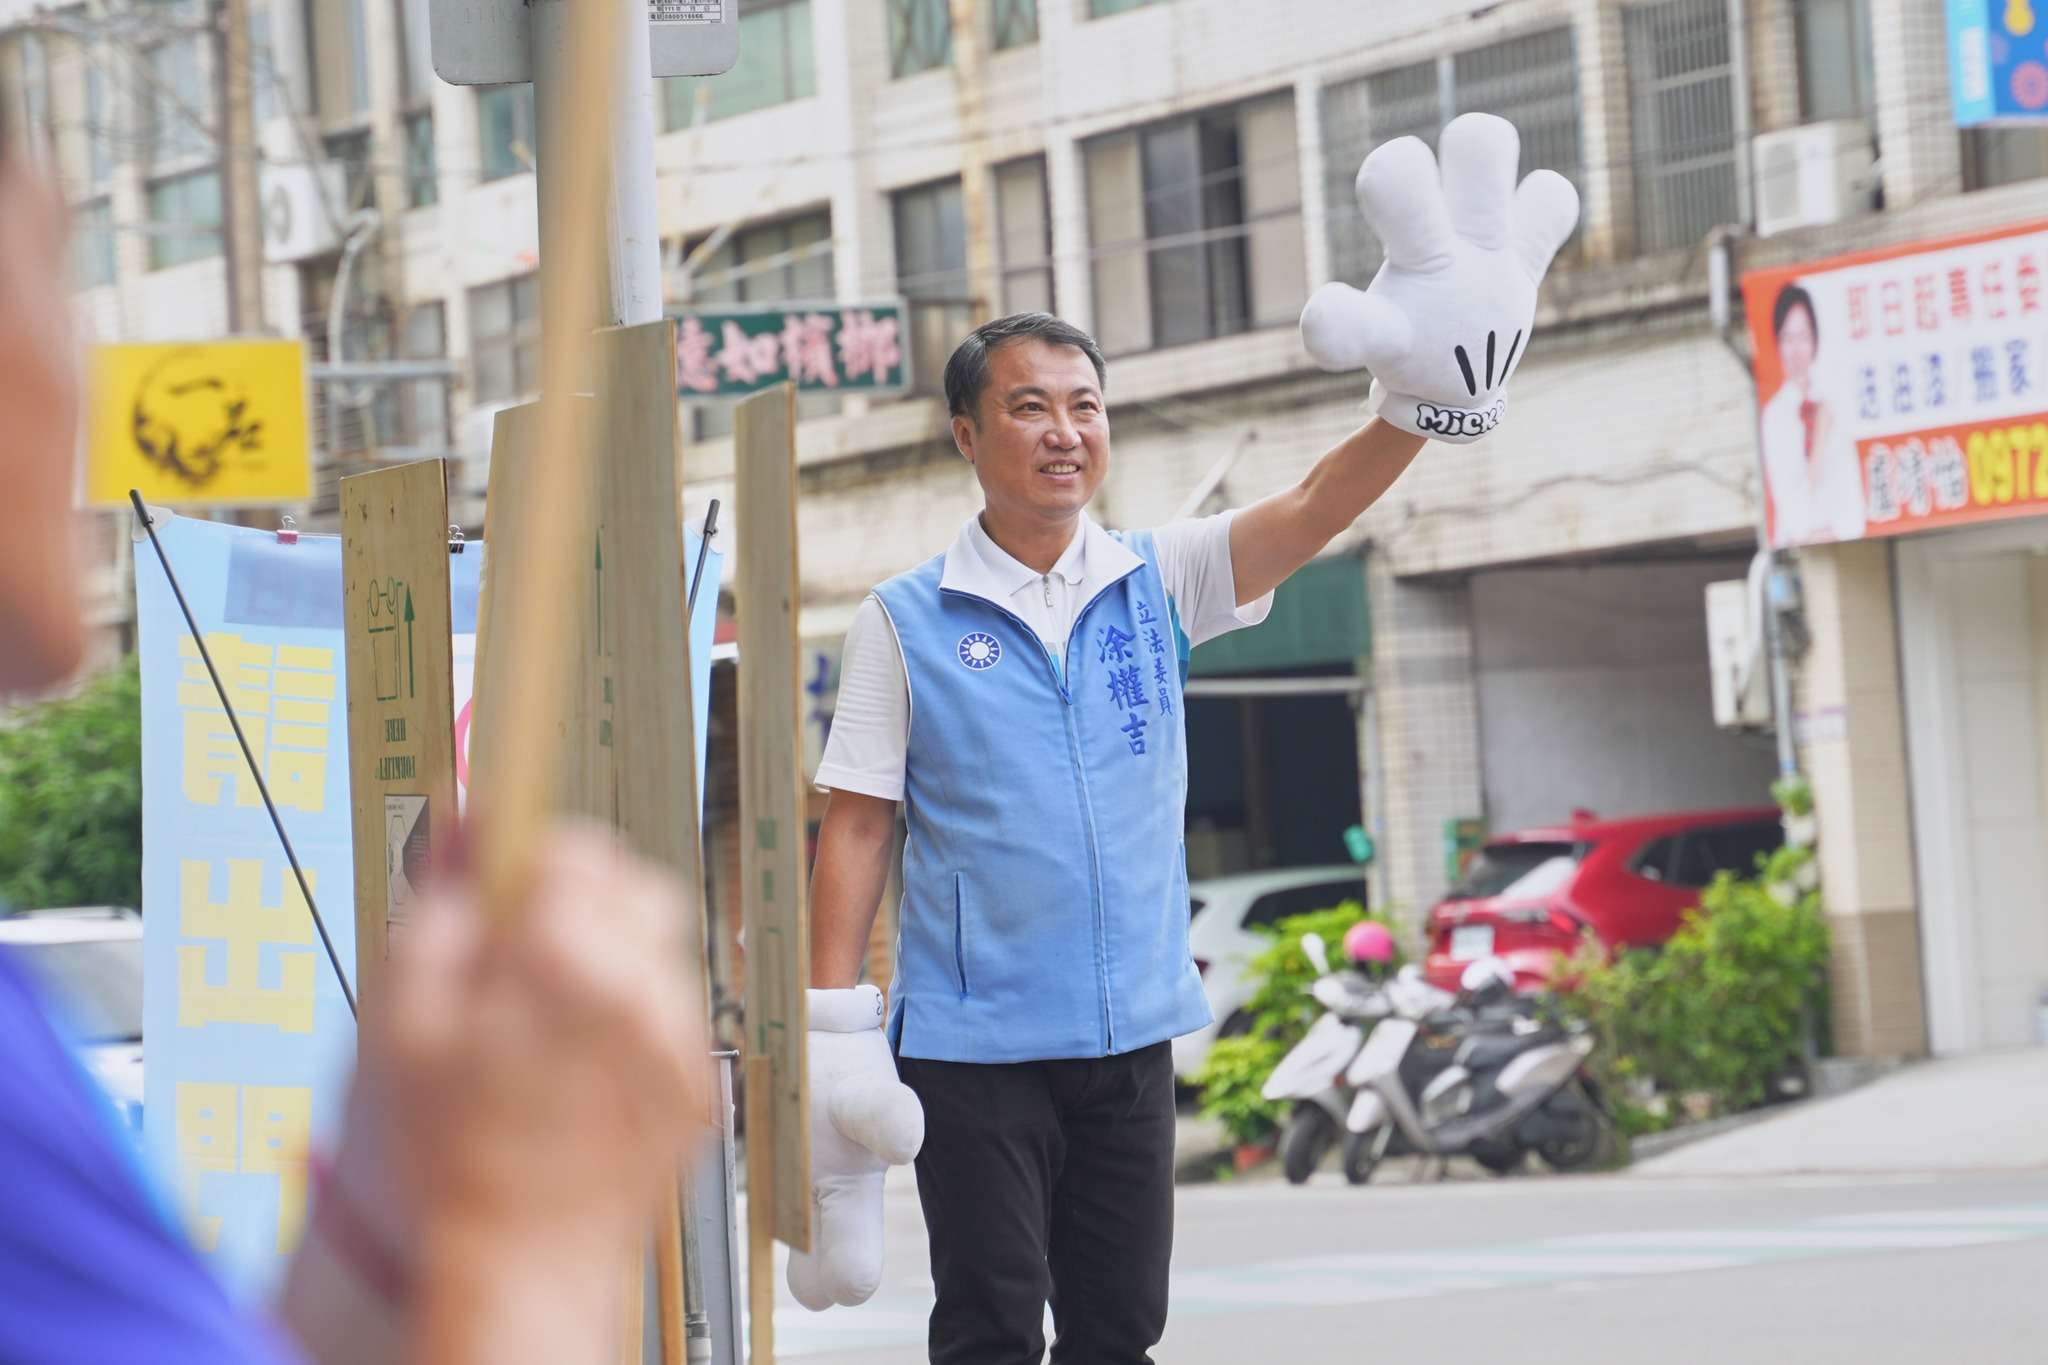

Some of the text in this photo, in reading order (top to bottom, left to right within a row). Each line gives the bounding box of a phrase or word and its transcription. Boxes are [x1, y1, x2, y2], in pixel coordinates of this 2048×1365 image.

[1096, 624, 1150, 757] 涂權吉
[1136, 600, 1173, 717] 立法委員
[384, 718, 407, 743] HERE
